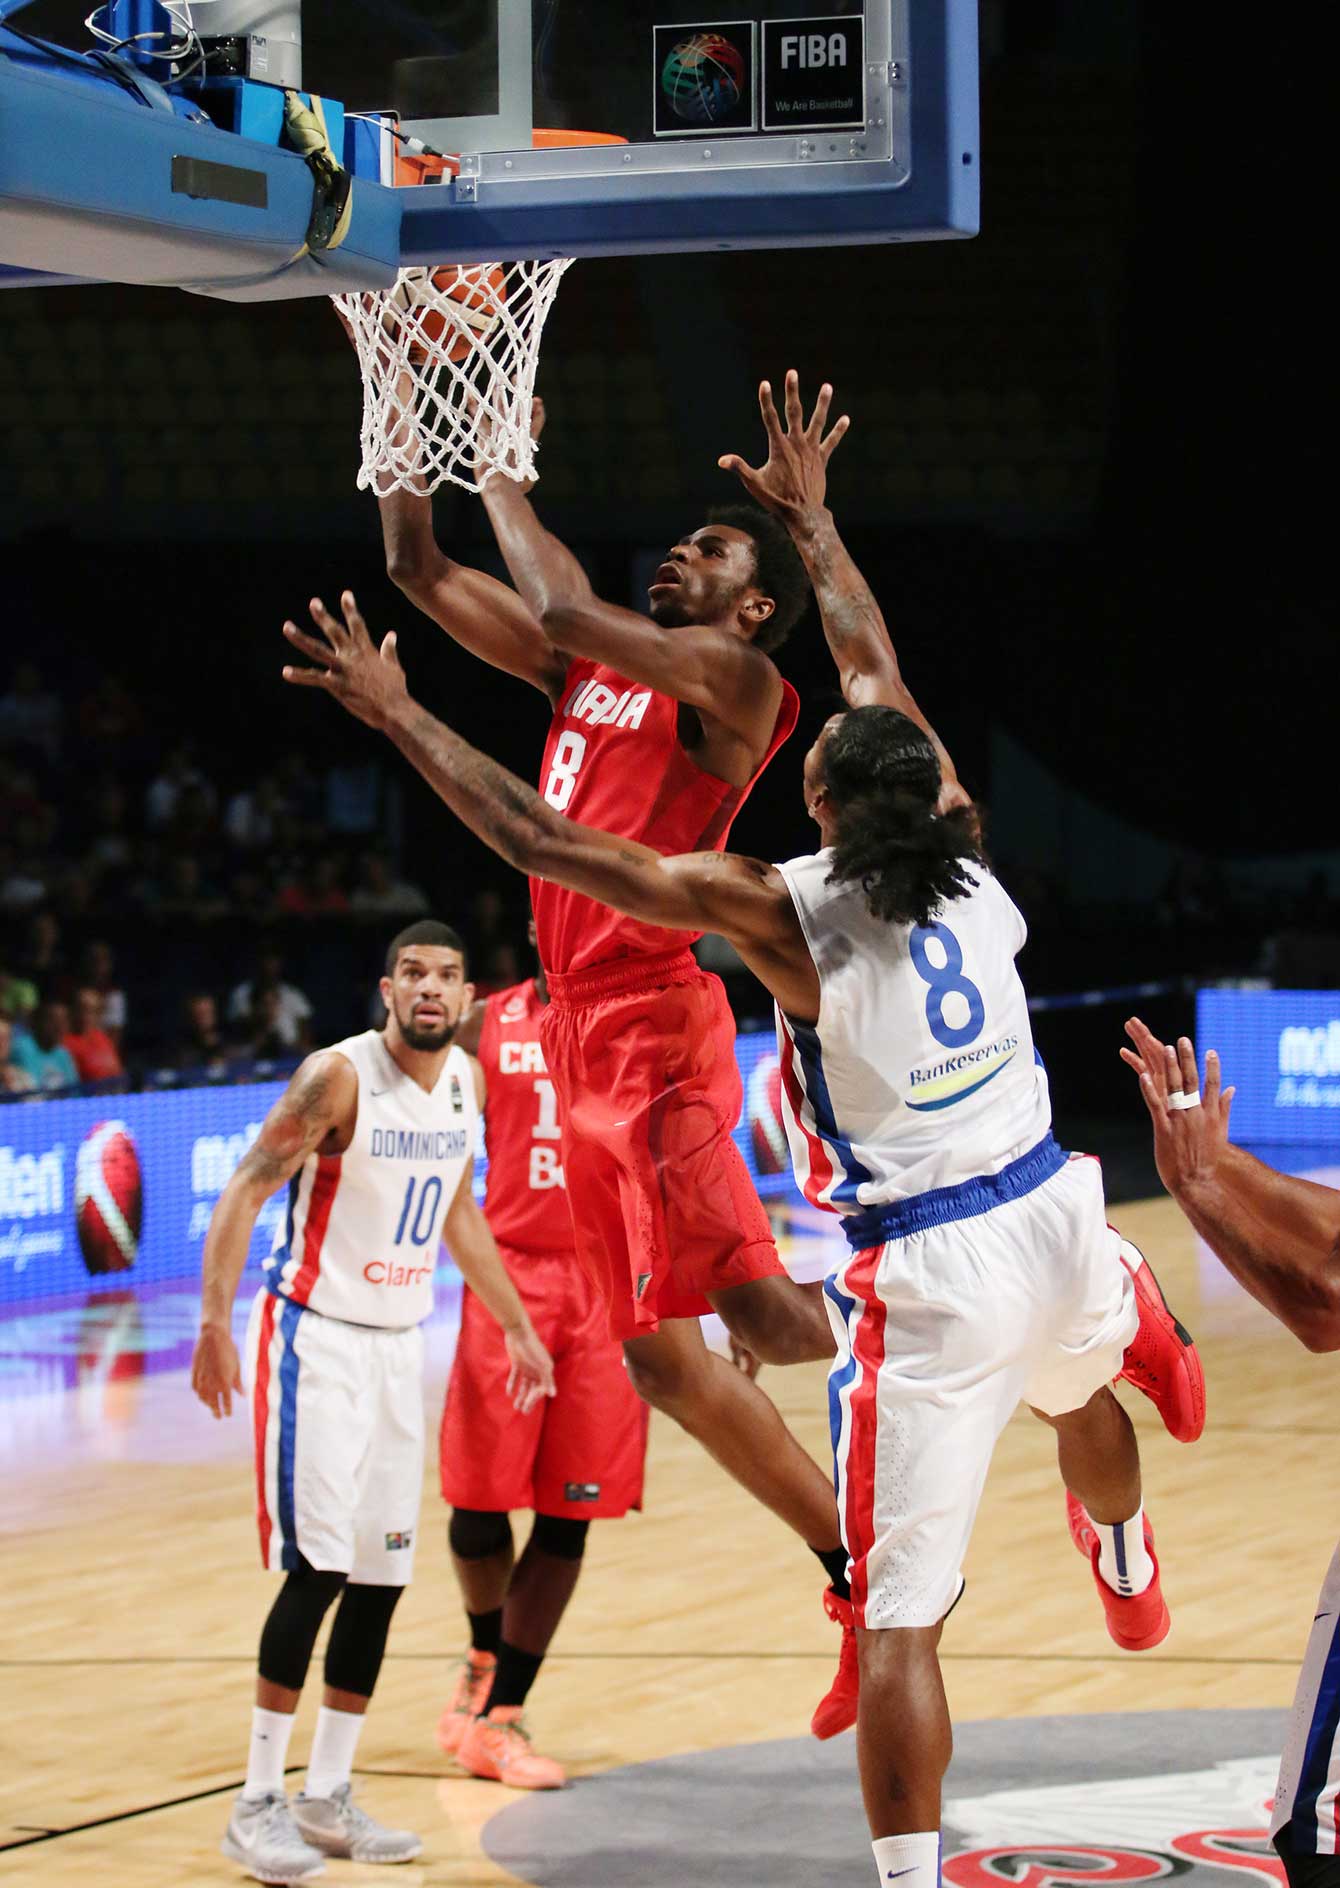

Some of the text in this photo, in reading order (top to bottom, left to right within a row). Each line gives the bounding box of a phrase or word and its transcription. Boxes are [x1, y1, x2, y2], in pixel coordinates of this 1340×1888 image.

[781, 33, 847, 69] FIBA
[775, 101, 791, 112] We
[792, 100, 808, 111] Are
[544, 730, 587, 812] 8
[909, 920, 985, 1048] 8
[532, 1079, 562, 1140] 1
[371, 1128, 466, 1160] DOMINICANA
[394, 1175, 442, 1246] 10
